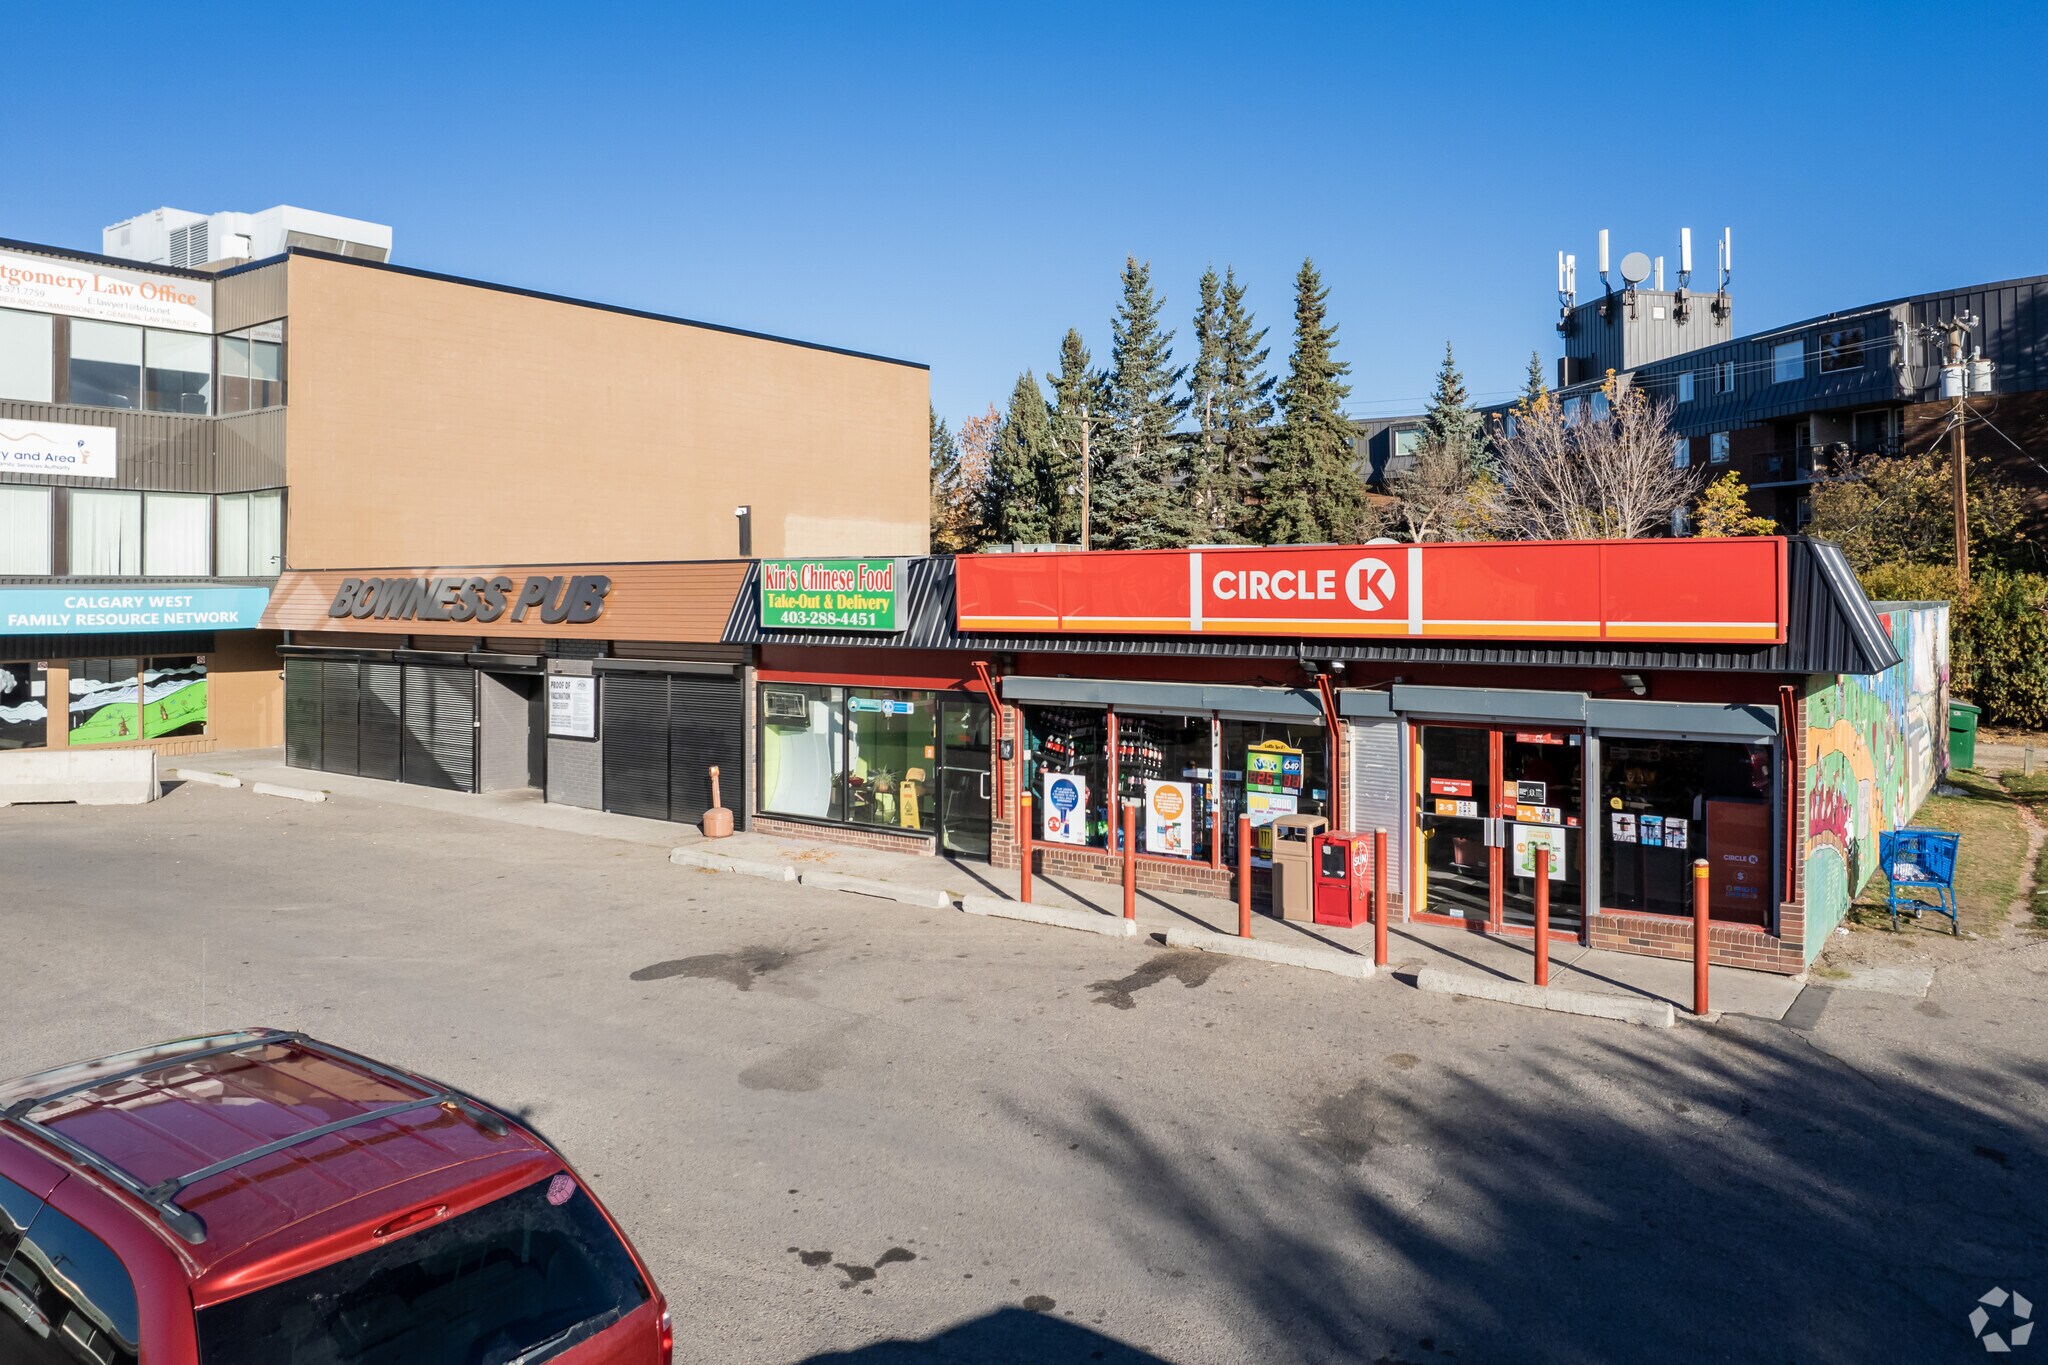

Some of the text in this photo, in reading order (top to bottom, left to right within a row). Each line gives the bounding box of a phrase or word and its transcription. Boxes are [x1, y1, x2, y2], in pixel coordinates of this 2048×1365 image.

[93, 272, 134, 297] Law
[140, 281, 197, 306] Office
[17, 298, 36, 307] AND
[37, 301, 96, 315] COMMISSIONS
[106, 310, 141, 321] GENERAL
[144, 316, 161, 324] LAW
[162, 317, 198, 328] PRACTICE
[14, 452, 40, 461] and
[44, 452, 76, 463] Area
[764, 563, 893, 592] Kin's Chinese Food
[1212, 569, 1336, 601] CIRCLE
[64, 595, 193, 609] CALGARY WEST
[328, 575, 613, 624] BOWNESS PUB
[767, 593, 890, 613] Take-Out & Delivery
[8, 611, 239, 627] FAMILY RESOURCE NETWORK
[780, 611, 876, 626] 403-288-4451
[1353, 853, 1367, 867] SUN
[1723, 854, 1758, 864] CIRCLE K
